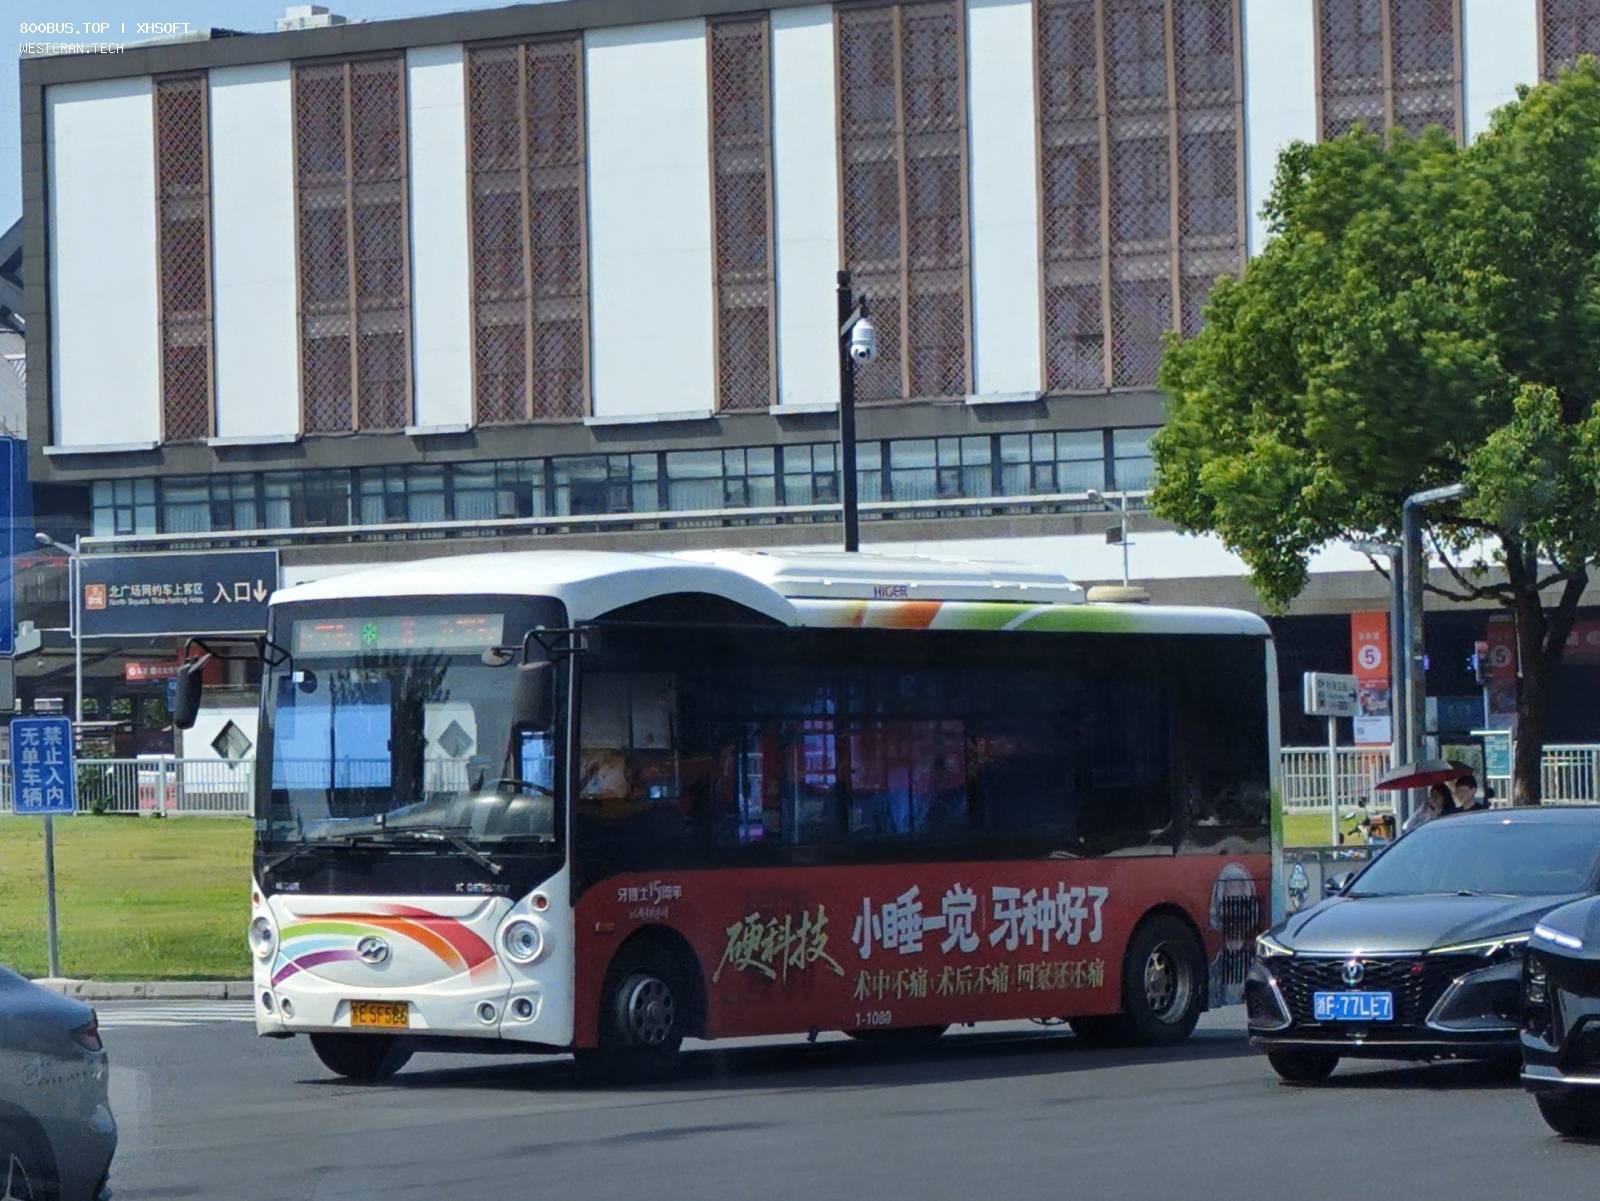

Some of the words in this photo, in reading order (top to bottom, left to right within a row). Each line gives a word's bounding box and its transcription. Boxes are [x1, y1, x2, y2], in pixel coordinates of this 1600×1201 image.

[212, 581, 251, 604] 入口
[1365, 648, 1376, 665] 5
[20, 727, 43, 807] 无单车辆
[43, 726, 65, 806] 禁止入内
[712, 903, 846, 986] 硬科技
[852, 882, 980, 960] 小睡一觉
[988, 881, 1109, 952] 牙种好了
[853, 966, 928, 1001] 术中不痛
[936, 961, 1009, 997] 术后不痛
